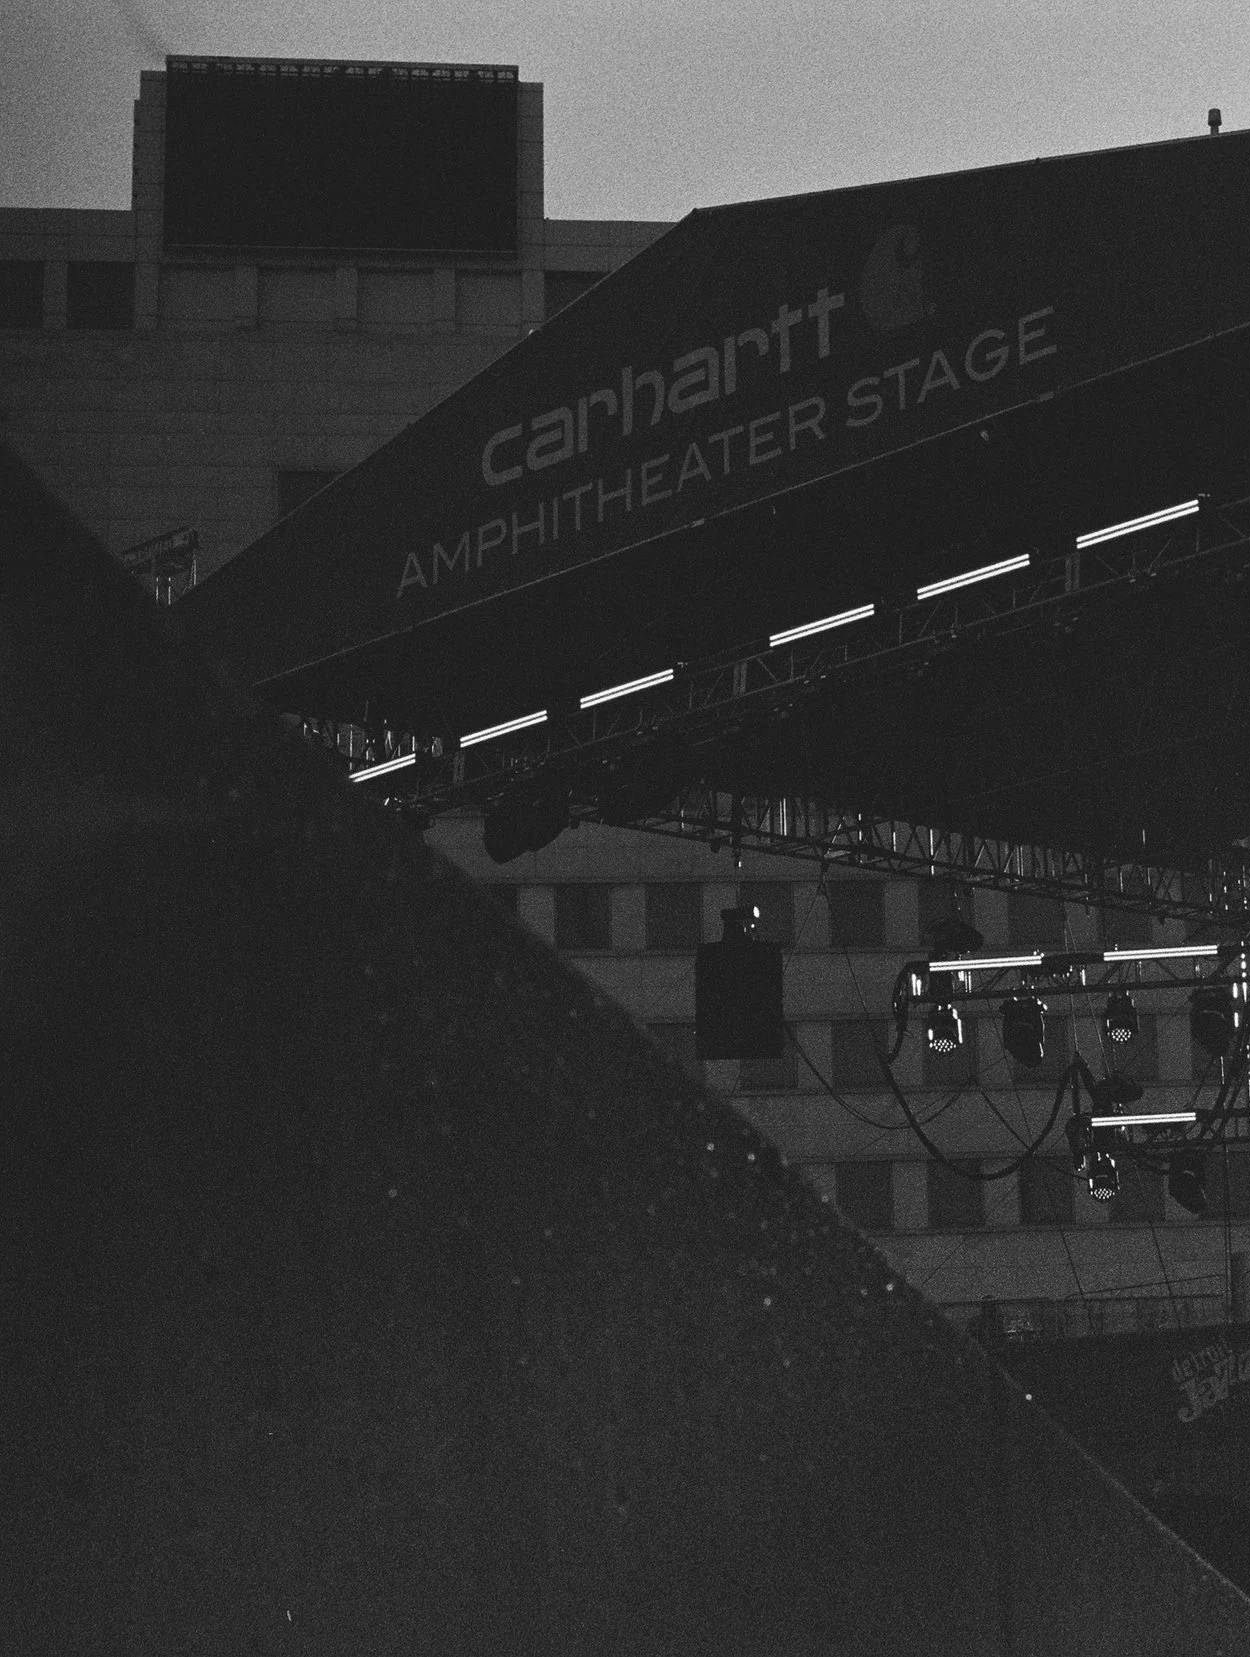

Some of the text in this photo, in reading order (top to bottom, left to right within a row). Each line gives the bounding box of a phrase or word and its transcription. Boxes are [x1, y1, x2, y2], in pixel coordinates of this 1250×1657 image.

[397, 304, 1059, 600] AMPHITHEATER STAGE
[481, 286, 846, 487] carhartt
